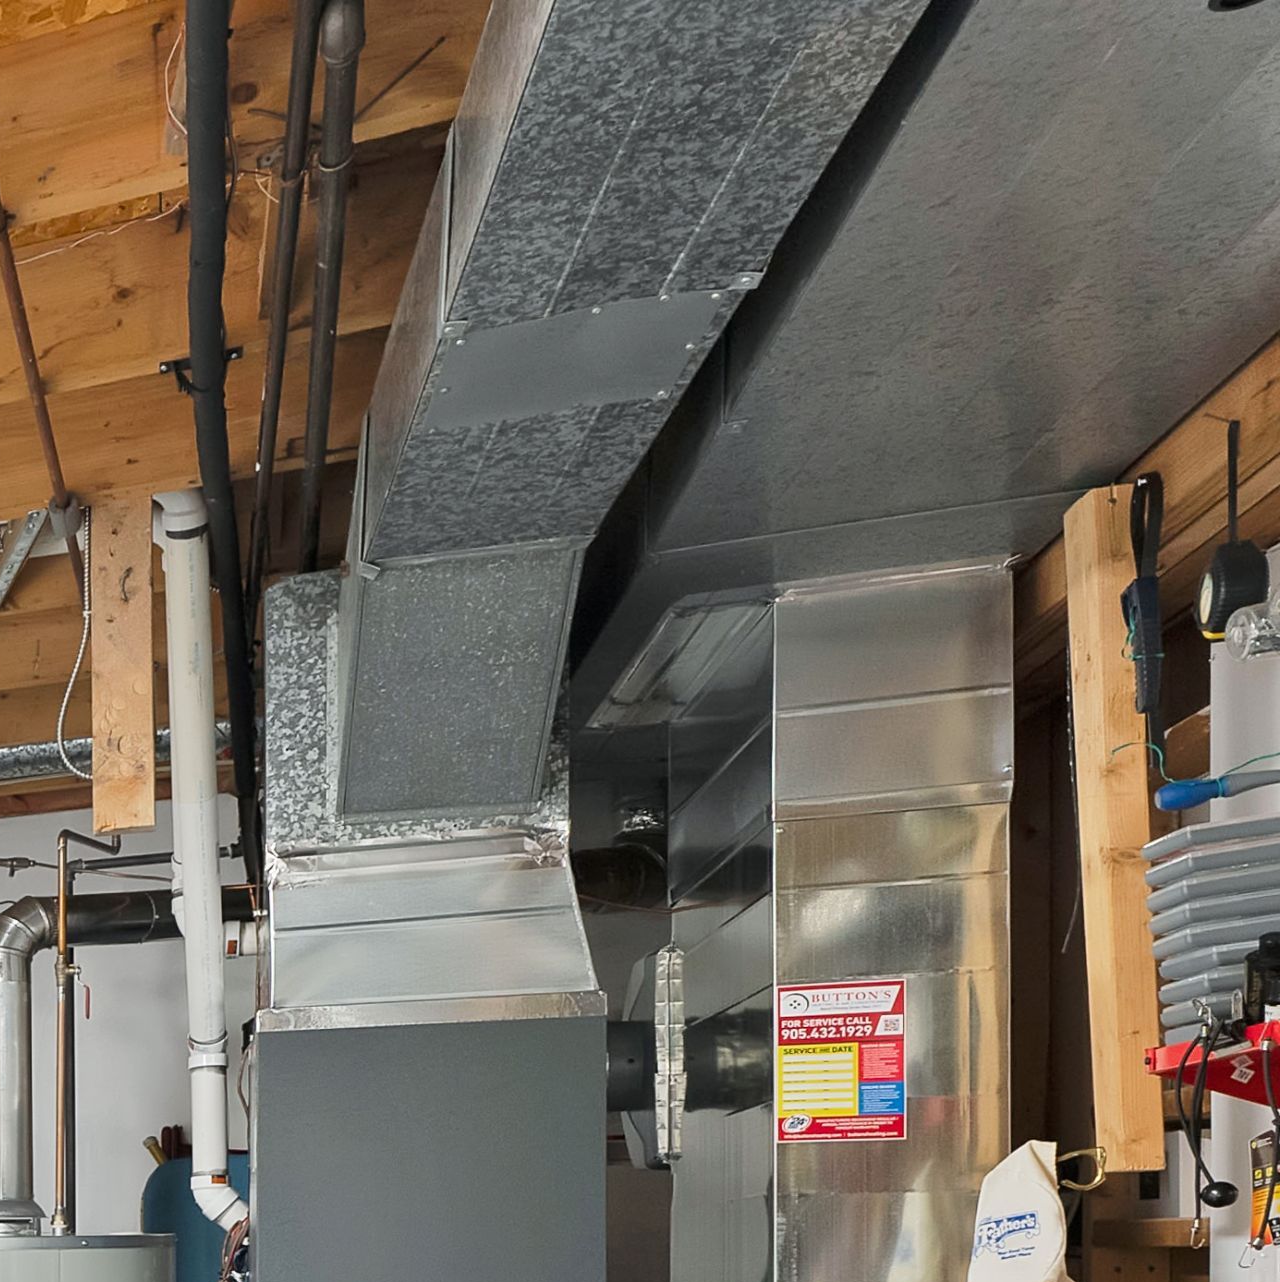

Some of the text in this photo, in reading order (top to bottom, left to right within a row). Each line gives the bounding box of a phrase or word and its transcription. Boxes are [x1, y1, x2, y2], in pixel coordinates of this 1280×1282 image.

[811, 990, 891, 1003] BUTTON'S
[781, 1017, 872, 1028] FOR SERVICE CALL
[781, 1026, 872, 1040] 905.432.1929
